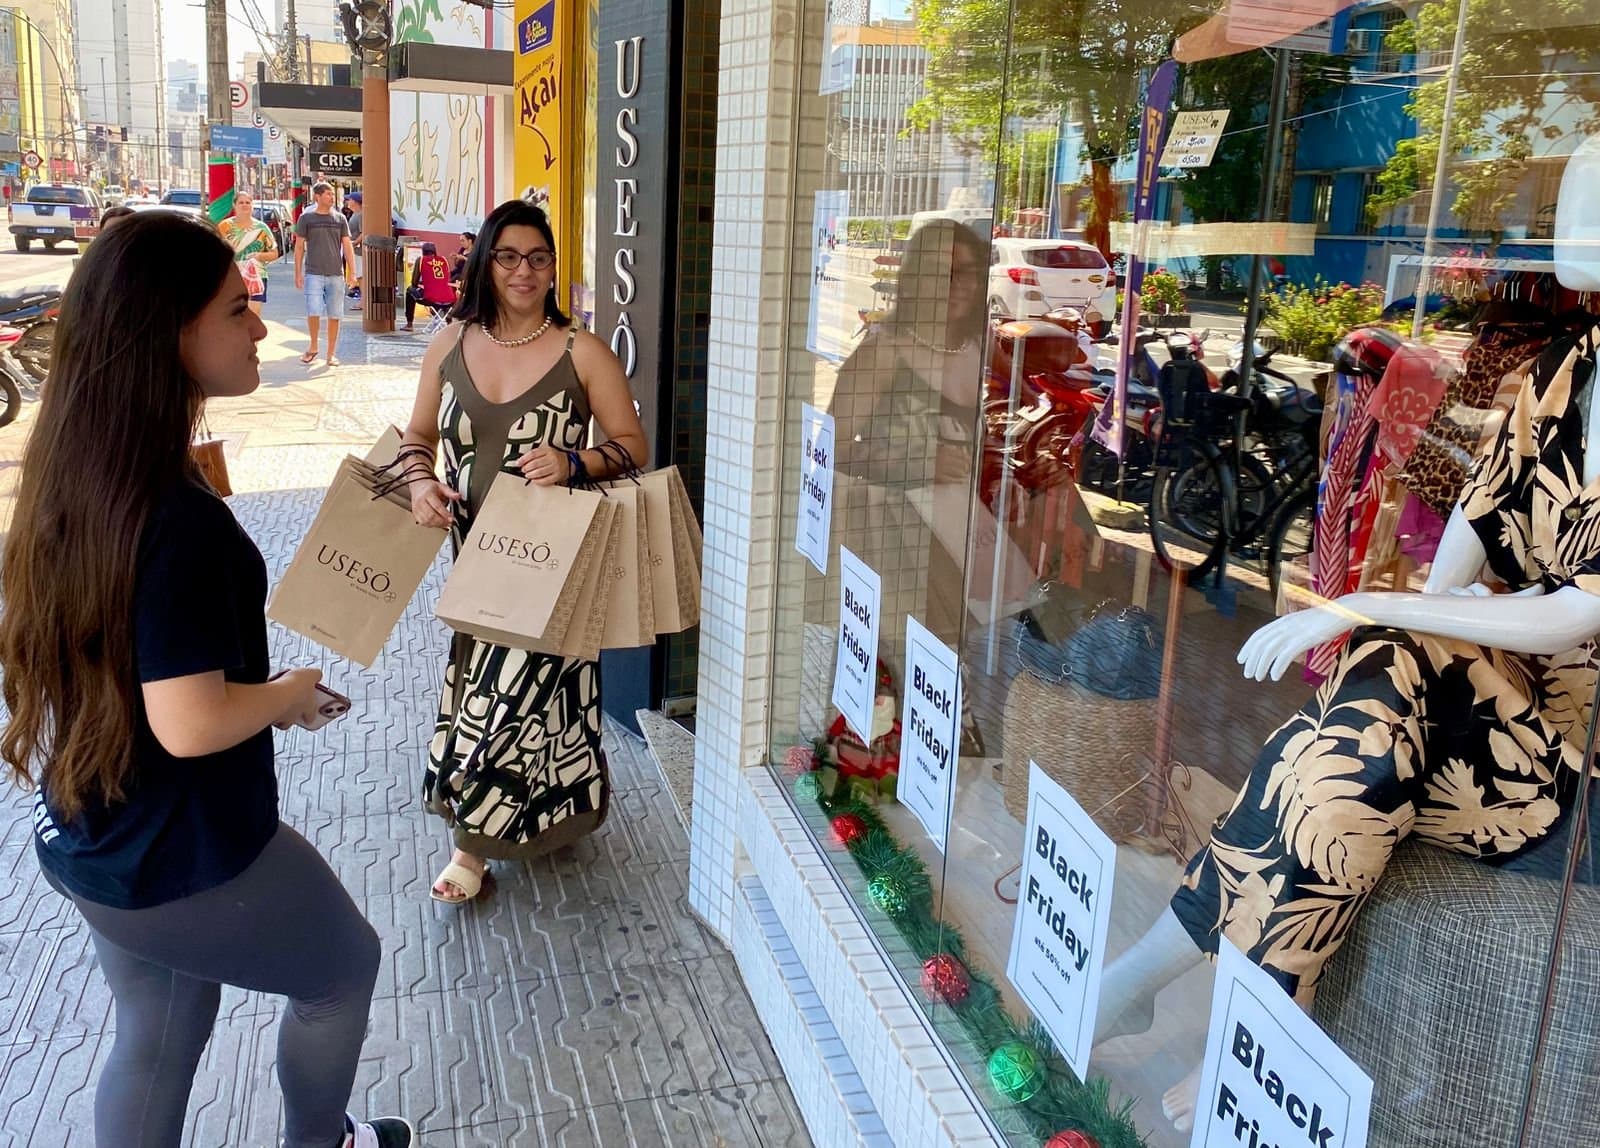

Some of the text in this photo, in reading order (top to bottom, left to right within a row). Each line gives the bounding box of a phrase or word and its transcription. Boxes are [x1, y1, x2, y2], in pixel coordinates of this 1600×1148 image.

[230, 87, 240, 102] E
[521, 61, 557, 126] Açaí
[269, 126, 277, 136] E
[319, 154, 353, 167] CRIS
[611, 36, 645, 377] USESÔ
[432, 265, 444, 278] 2
[803, 473, 826, 509] Friday
[317, 544, 391, 592] USESÔ
[478, 532, 551, 563] USESÔ
[844, 586, 871, 630] Black
[842, 624, 870, 673] Friday
[914, 664, 951, 719] Black
[910, 707, 949, 771] Friday
[1035, 824, 1094, 913] Black
[1027, 874, 1089, 972] Friday
[1034, 936, 1072, 985] até 50% off
[1232, 1020, 1335, 1148] Black
[1217, 1082, 1280, 1148] Fri
